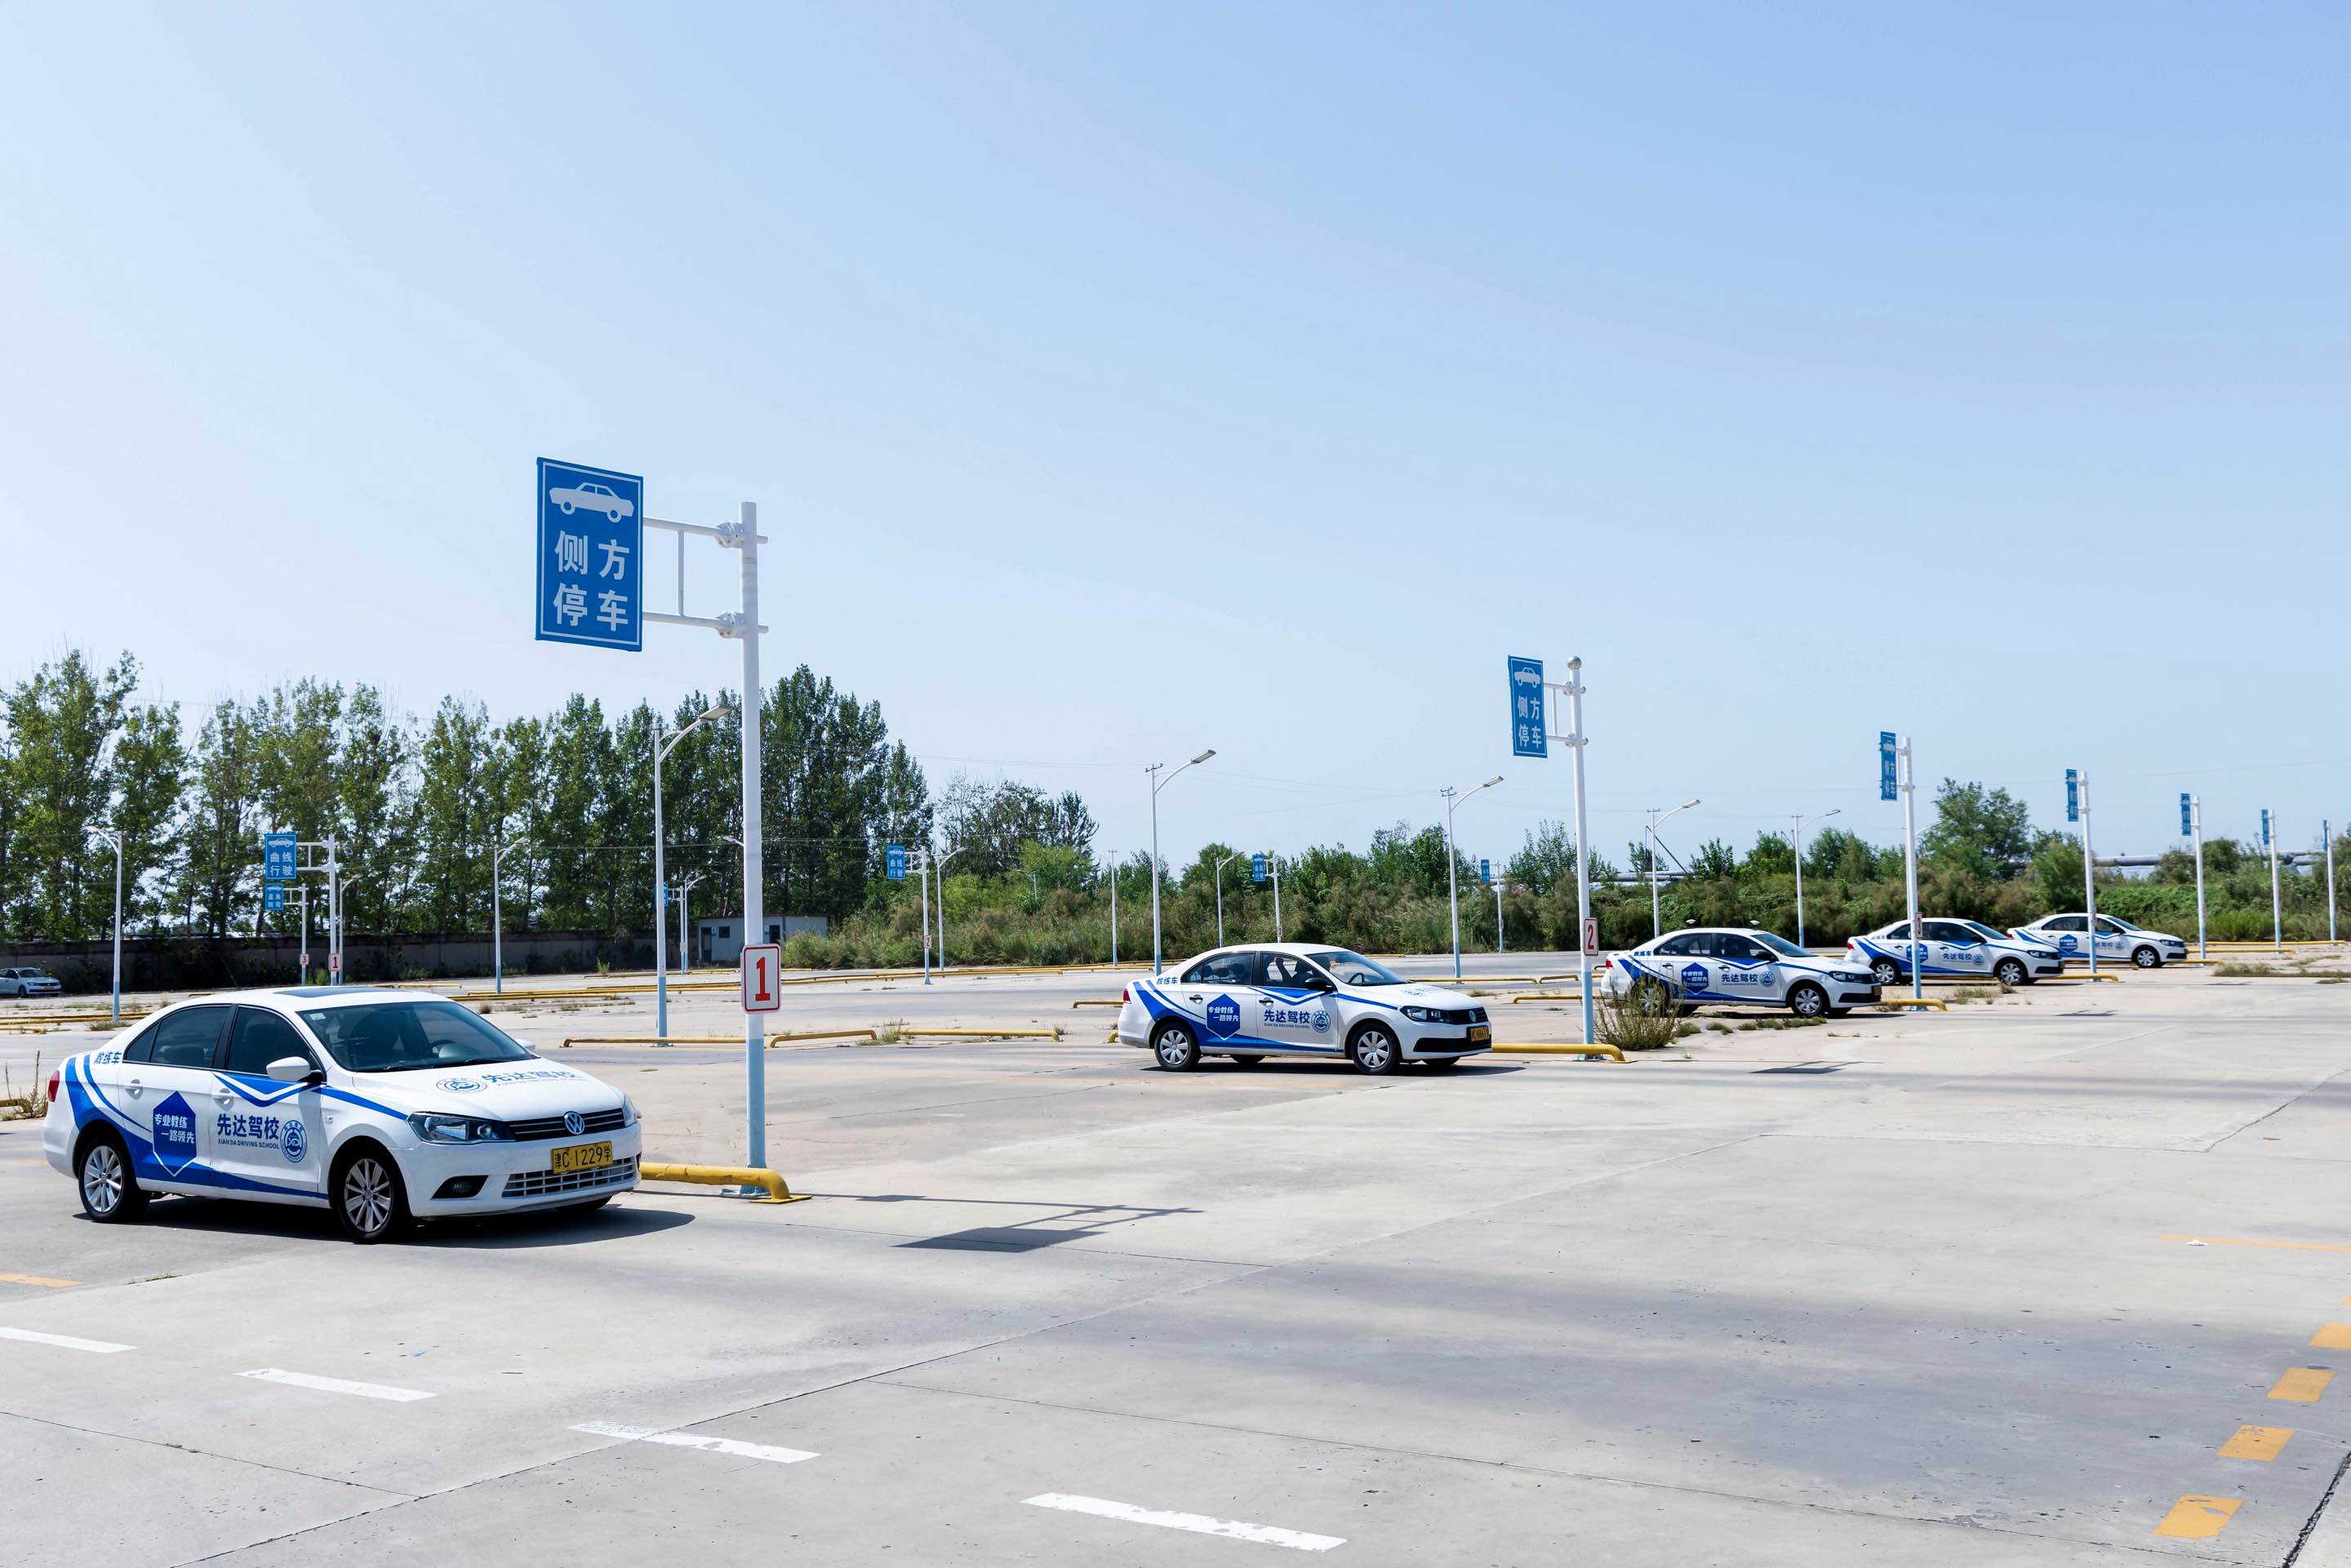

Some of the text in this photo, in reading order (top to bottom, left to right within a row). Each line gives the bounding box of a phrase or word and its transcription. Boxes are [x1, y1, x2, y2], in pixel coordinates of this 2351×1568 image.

[553, 530, 630, 580] 侧方
[553, 582, 629, 632] 停车
[1518, 695, 1540, 720] 侧方
[1518, 723, 1542, 748] 停车
[270, 851, 293, 863] 曲线
[270, 865, 293, 876] 行驶
[1587, 924, 1594, 950] 2
[302, 955, 307, 963] 3
[332, 956, 338, 969] 1
[755, 957, 771, 1002] 1
[1264, 1010, 1310, 1024] 先达驾校
[154, 1113, 188, 1128] 专业教练
[217, 1113, 279, 1139] 先达驾校
[161, 1130, 195, 1144] 一路领先
